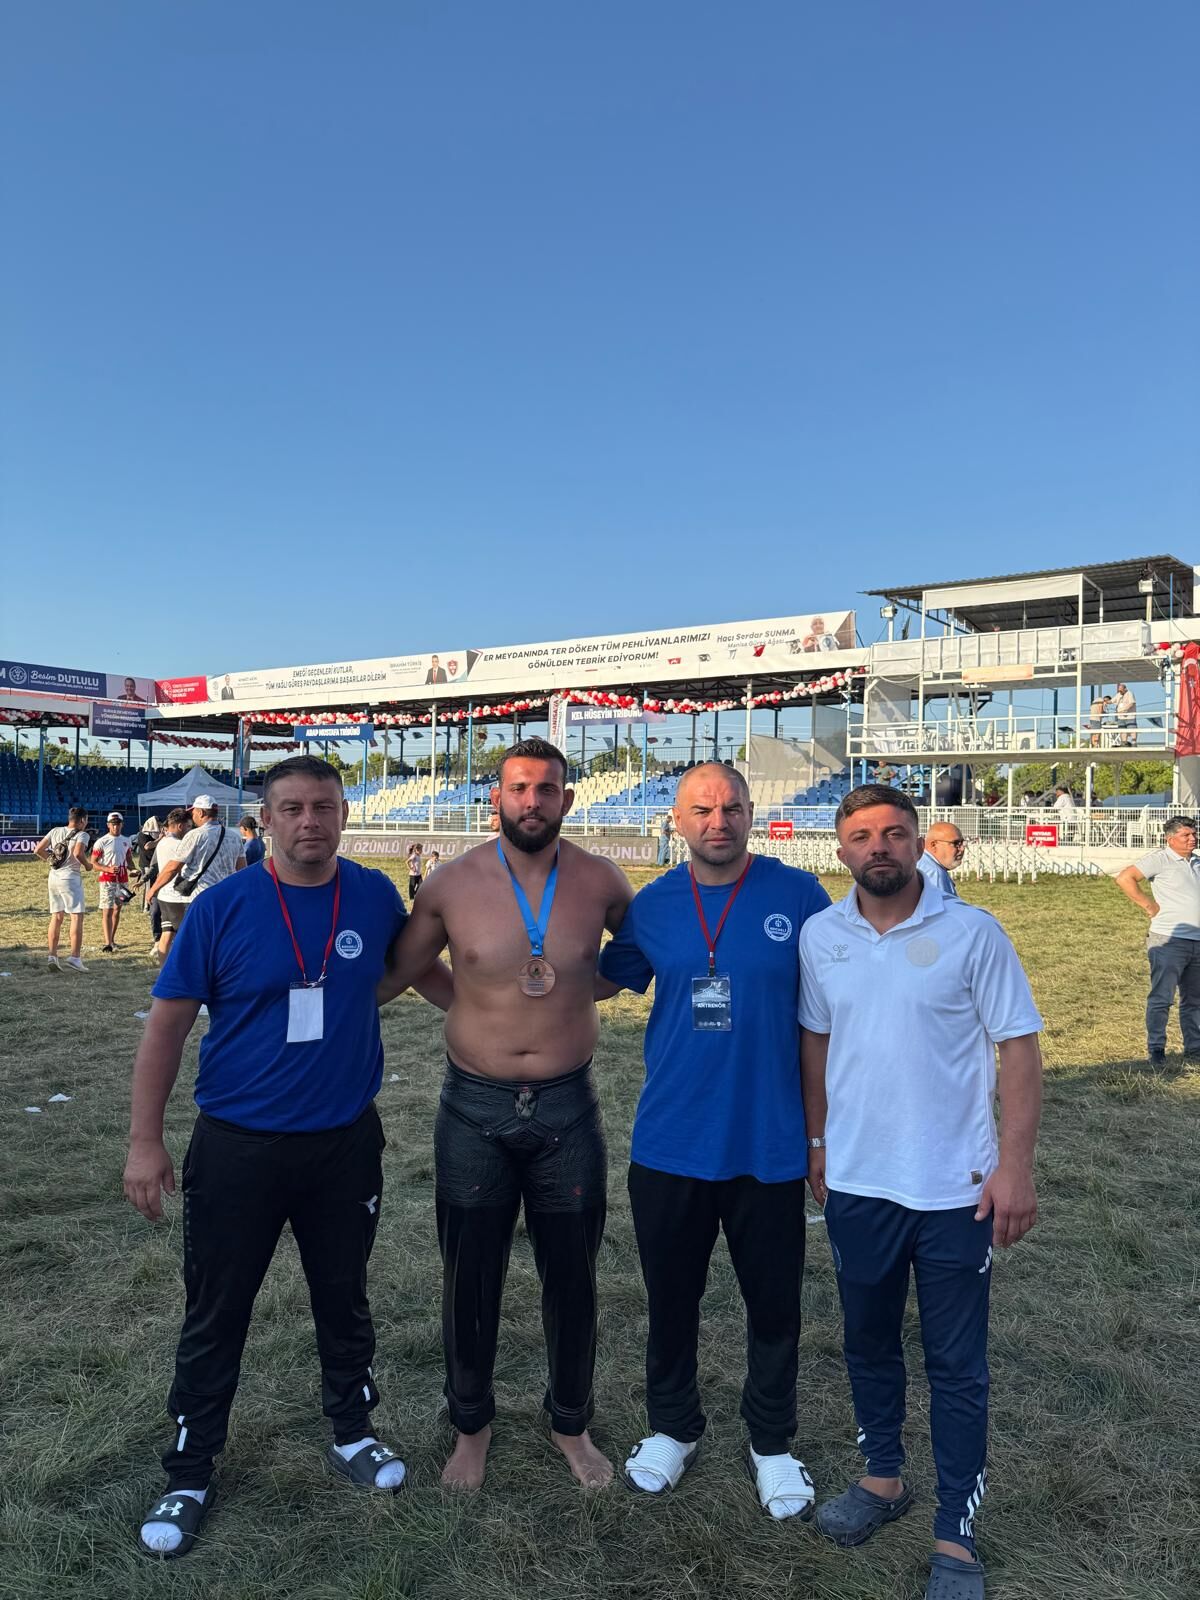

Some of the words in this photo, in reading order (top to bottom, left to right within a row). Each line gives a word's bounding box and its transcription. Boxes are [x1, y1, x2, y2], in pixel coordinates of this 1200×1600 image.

[736, 632, 763, 641] Serdar
[764, 628, 796, 637] SUNMA
[483, 654, 494, 662] ER
[495, 649, 549, 661] MEYDANINDA
[551, 647, 567, 656] TER
[568, 644, 599, 654] DÖKEN
[601, 641, 620, 651] TÜM
[622, 633, 711, 649] PEHLİVANLARIMIZI
[528, 659, 574, 669] GÖNÜLDEN
[576, 655, 606, 666] TEBRİK
[607, 651, 659, 662] EDİYORUM!
[31, 670, 56, 680] Besim
[58, 673, 99, 686] DUTLULU
[571, 711, 584, 720] KEL
[584, 708, 612, 720] HÜSEYİN
[1, 839, 40, 852] ÖZÜN
[353, 840, 400, 854] ÖZÜNLÜ
[406, 840, 456, 855] ÖÜNLÜ
[589, 843, 652, 860] ÖZÜNLÜ
